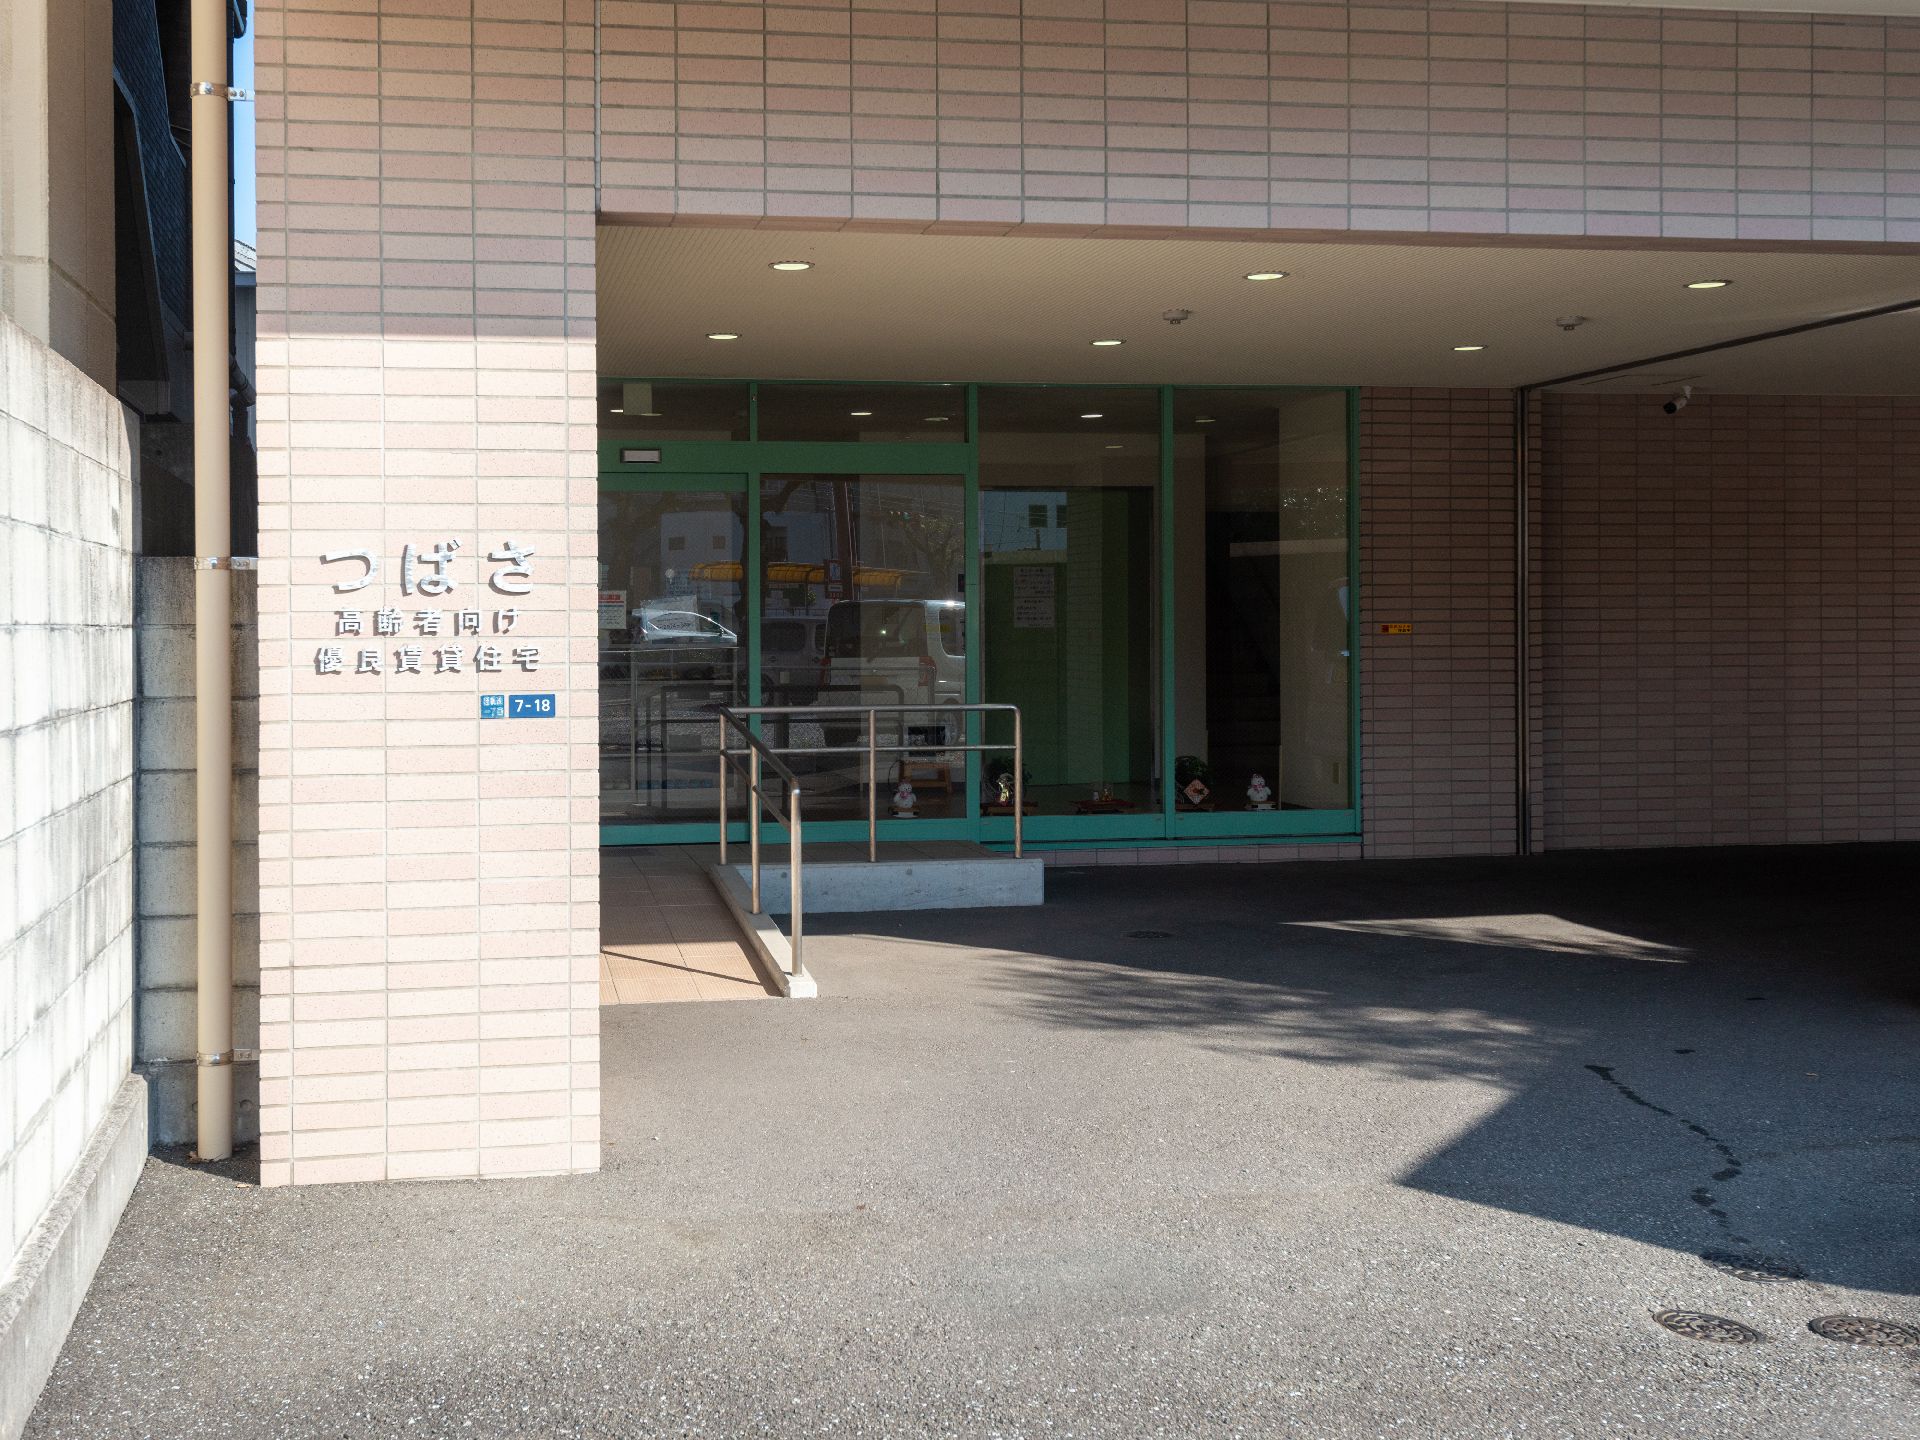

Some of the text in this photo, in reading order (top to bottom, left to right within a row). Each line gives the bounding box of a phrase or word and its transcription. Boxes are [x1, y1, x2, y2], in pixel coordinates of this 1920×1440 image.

[321, 540, 535, 595] つばさ
[335, 607, 521, 635] 高齢者向け
[314, 645, 543, 675] 優良賃貸住宅
[514, 699, 551, 712] 7-18
